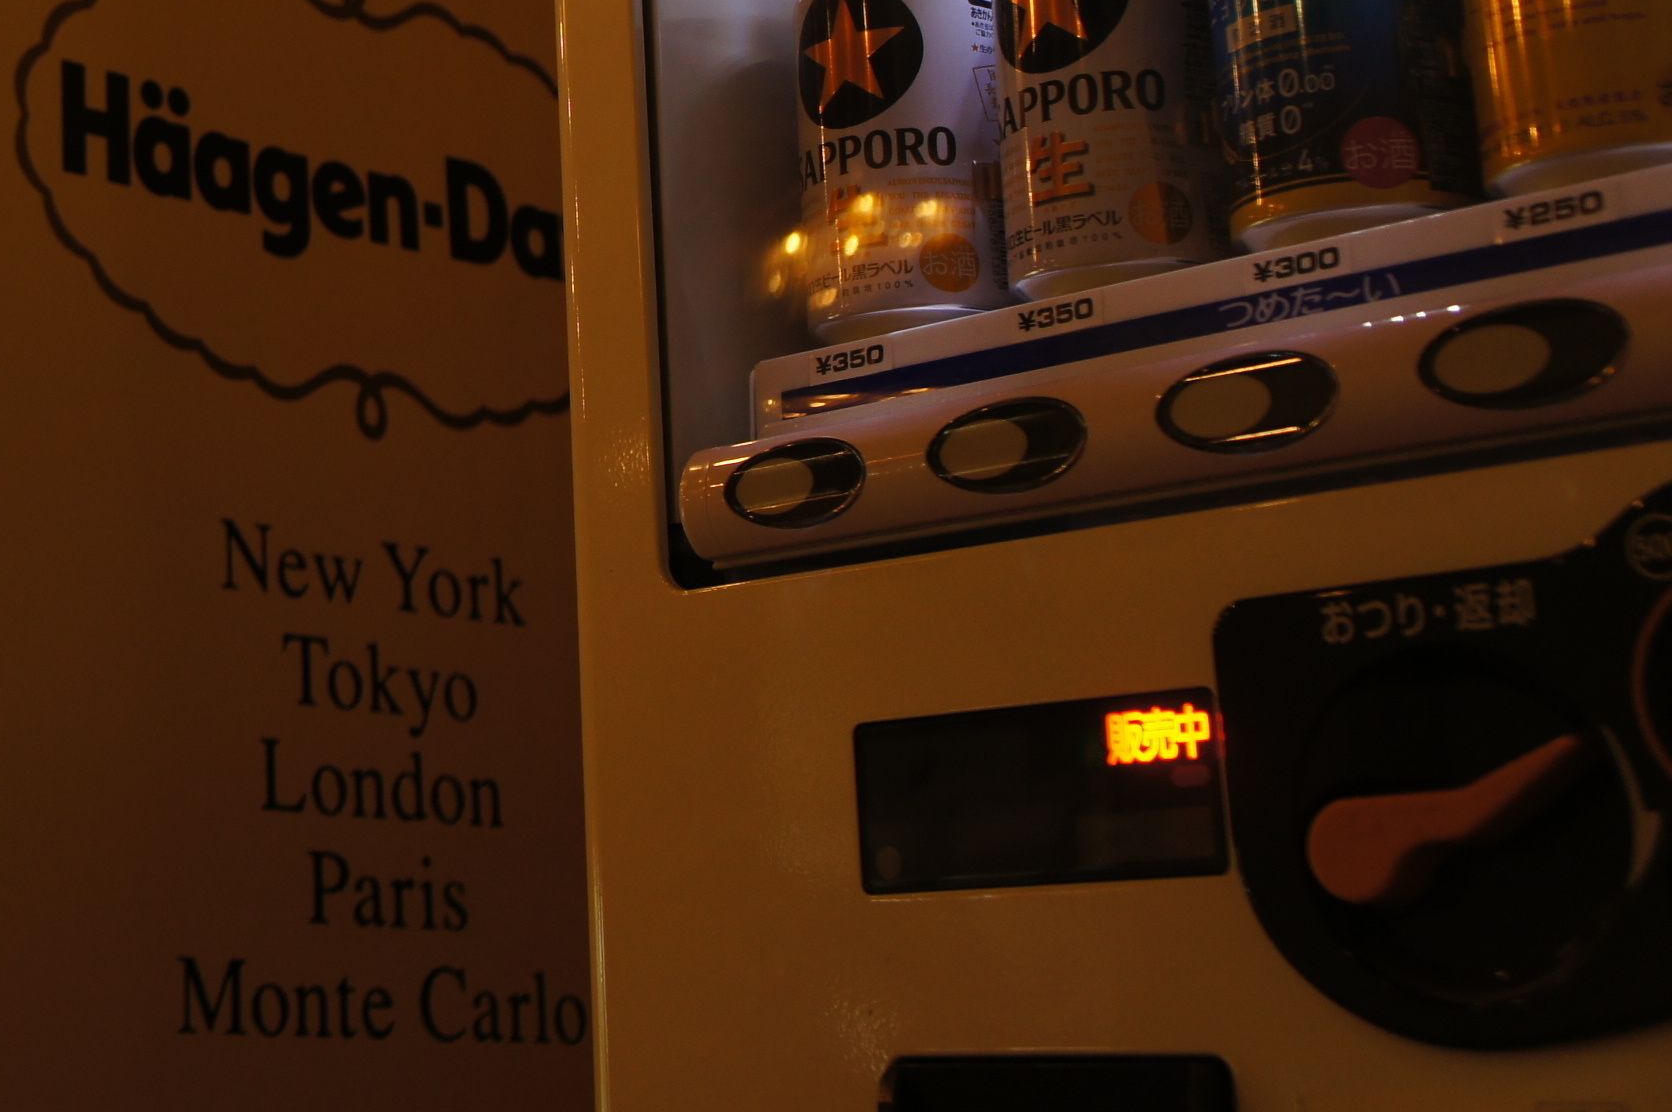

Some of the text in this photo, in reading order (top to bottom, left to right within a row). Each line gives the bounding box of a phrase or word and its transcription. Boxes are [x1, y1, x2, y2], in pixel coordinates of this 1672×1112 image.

[1003, 69, 1166, 139] APPORO
[61, 59, 564, 281] Häagen-Da
[799, 126, 957, 192] APPORO
[1030, 131, 1096, 207] 生
[1343, 133, 1418, 170] お酒
[1504, 191, 1605, 229] ¥250
[923, 251, 977, 280] お酒
[1253, 246, 1340, 283] ¥300
[1018, 298, 1094, 331] ¥350
[816, 344, 884, 376] ¥350
[221, 518, 526, 627] New York
[1320, 577, 1538, 645] おつり・返却
[282, 633, 477, 738] Tokyo
[1104, 702, 1211, 766] 販売中
[260, 737, 503, 828] London
[308, 850, 469, 932] Paris
[177, 956, 586, 1045] Monte Carlo
